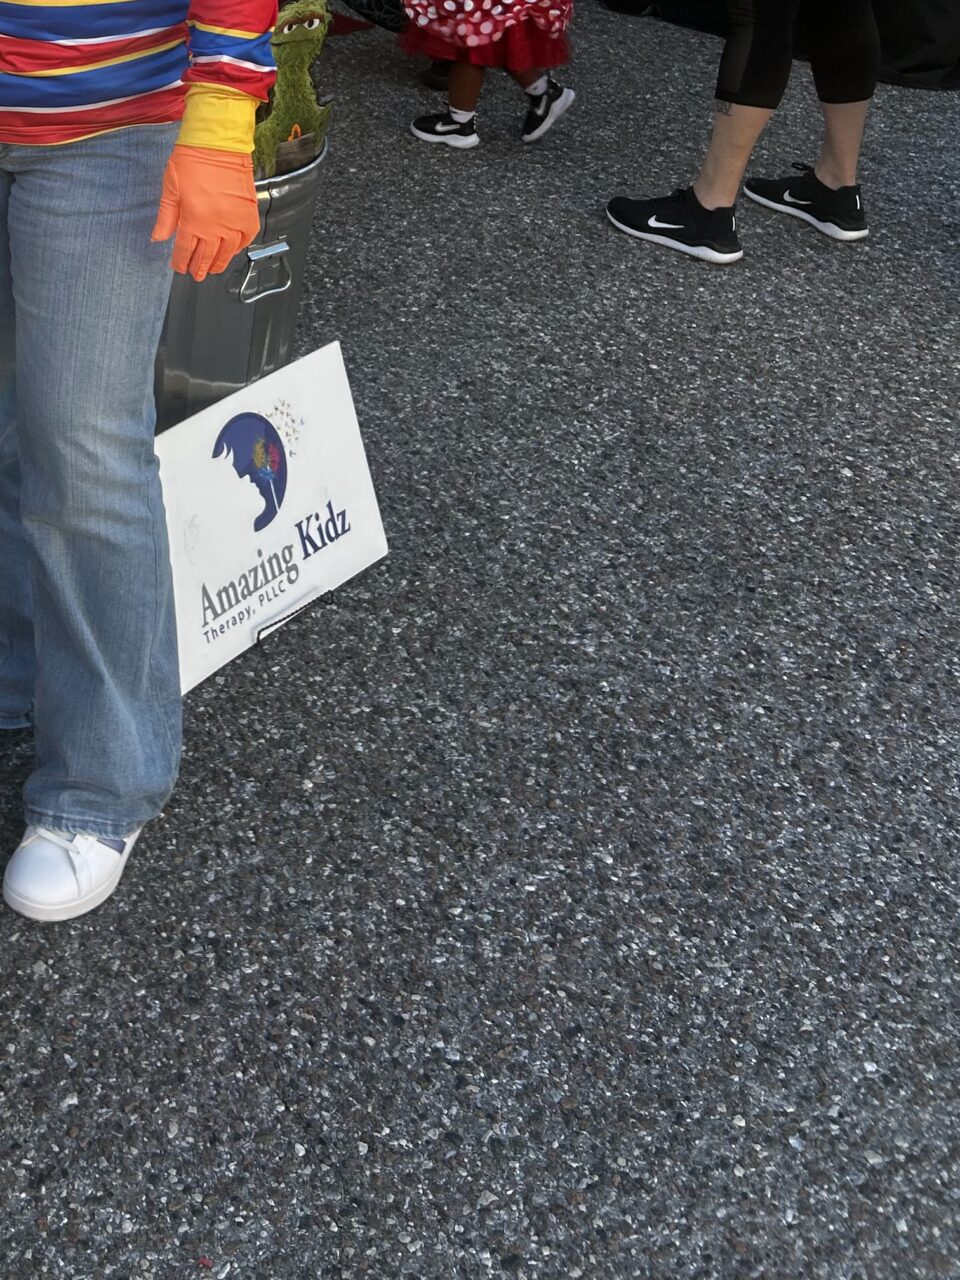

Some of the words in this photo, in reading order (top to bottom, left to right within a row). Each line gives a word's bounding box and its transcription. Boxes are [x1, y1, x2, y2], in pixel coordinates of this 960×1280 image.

[200, 543, 300, 627] Amazing
[295, 500, 351, 561] Kidz
[203, 602, 256, 645] Therapy,
[258, 581, 287, 608] PLLC
